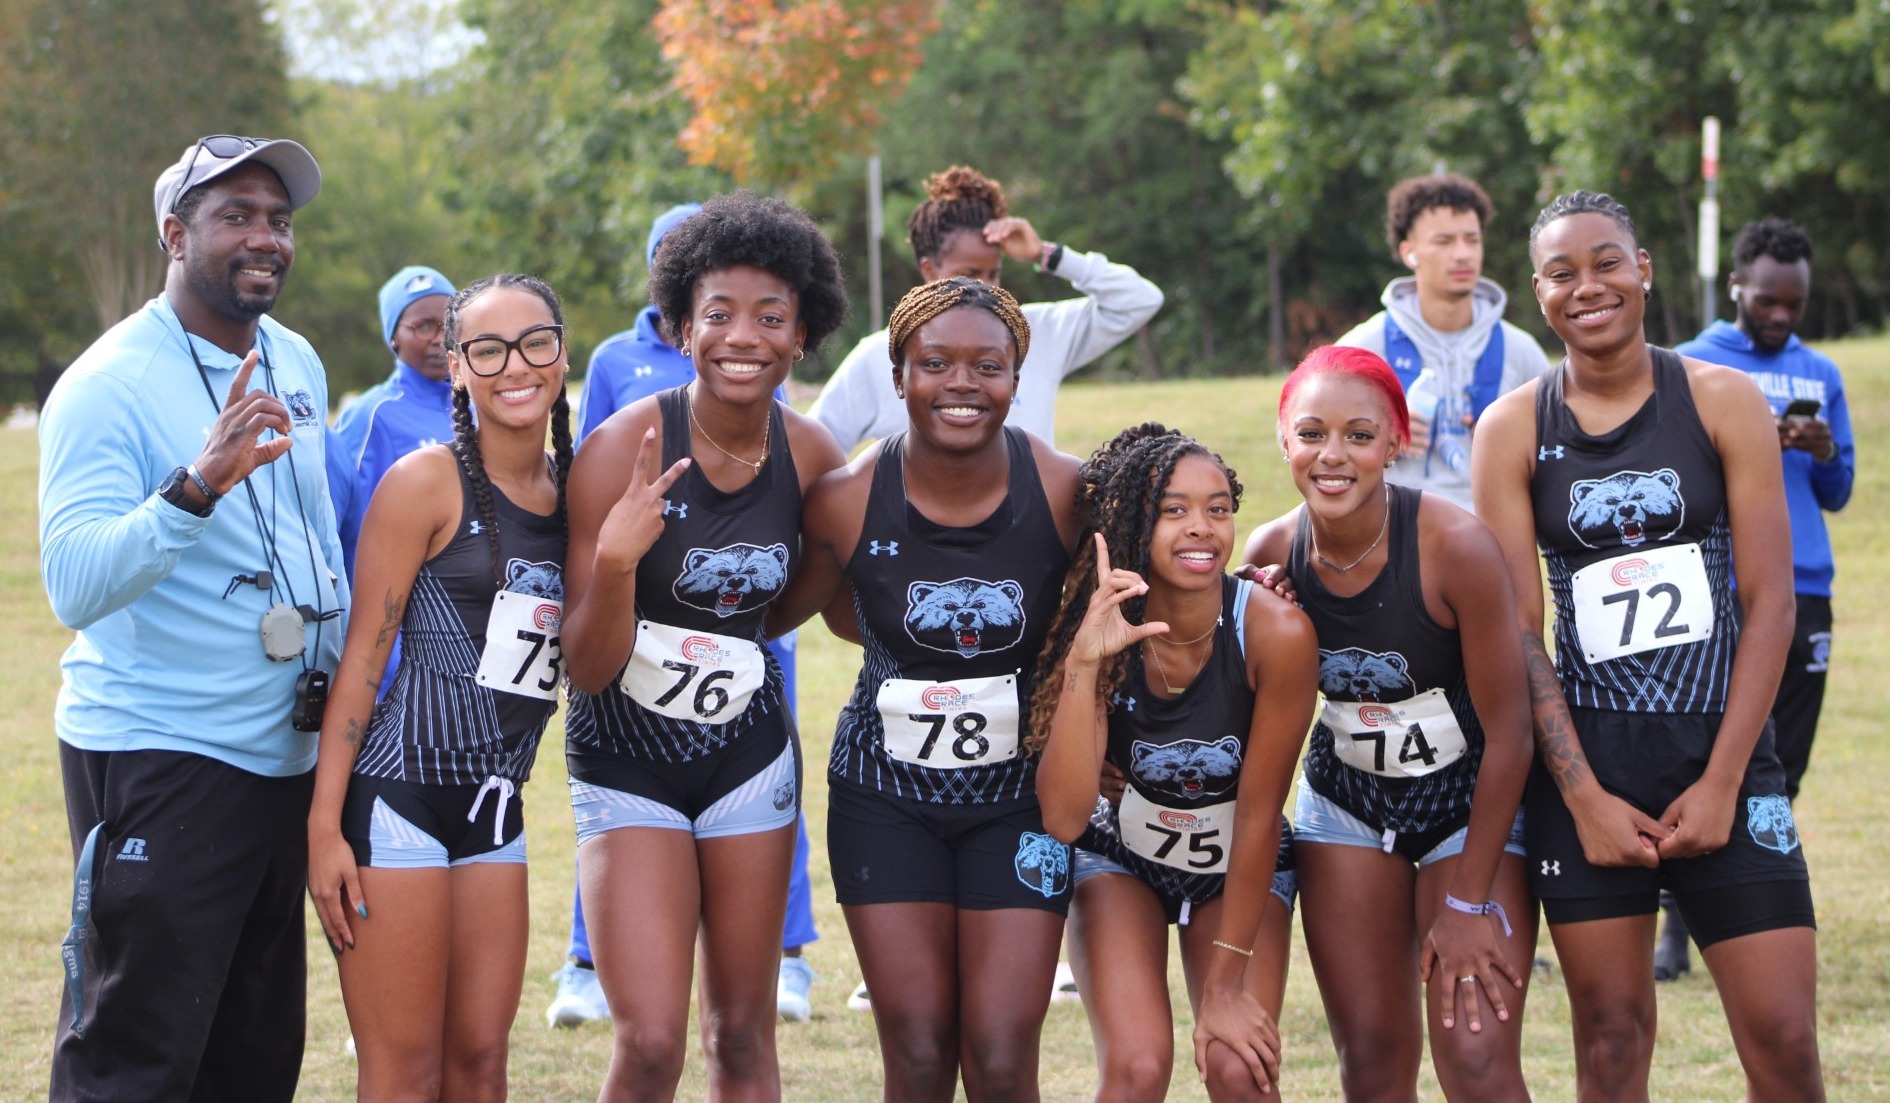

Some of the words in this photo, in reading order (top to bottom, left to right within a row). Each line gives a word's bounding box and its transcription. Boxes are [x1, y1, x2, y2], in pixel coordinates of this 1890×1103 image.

[1602, 583, 1690, 647] 72
[511, 630, 563, 692] 73
[653, 659, 735, 718] 76
[908, 712, 990, 761] 78
[1350, 722, 1439, 771] 74
[121, 837, 146, 855] R
[1145, 822, 1224, 869] 75
[77, 878, 89, 912] 1914
[63, 945, 79, 979] igma
